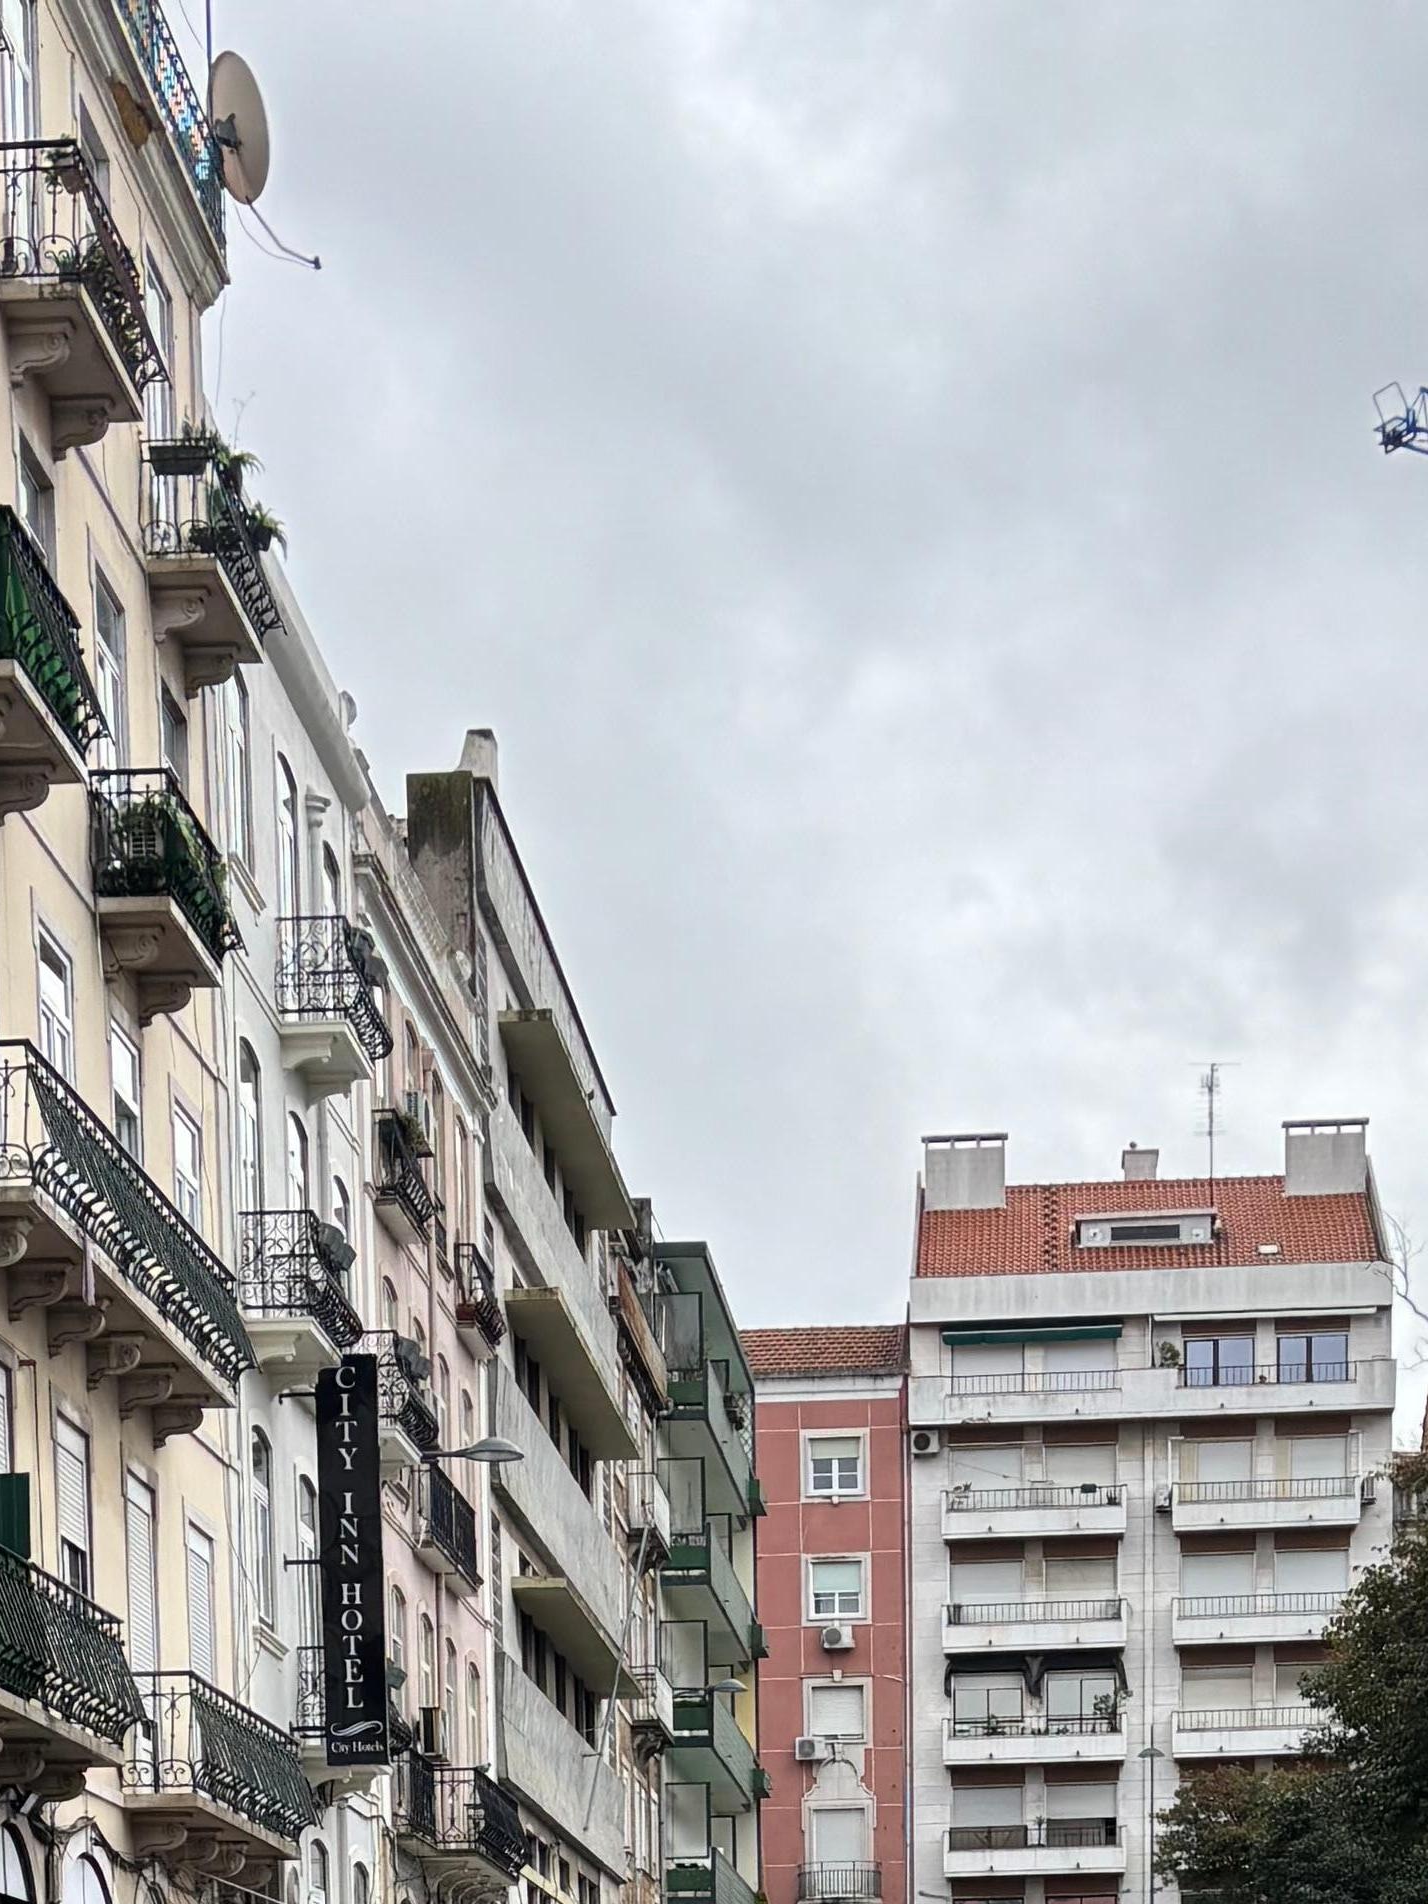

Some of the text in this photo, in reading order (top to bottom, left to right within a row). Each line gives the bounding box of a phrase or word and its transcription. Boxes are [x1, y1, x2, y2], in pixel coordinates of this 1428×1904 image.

[334, 1365, 365, 1709] CITY INN HOTEL
